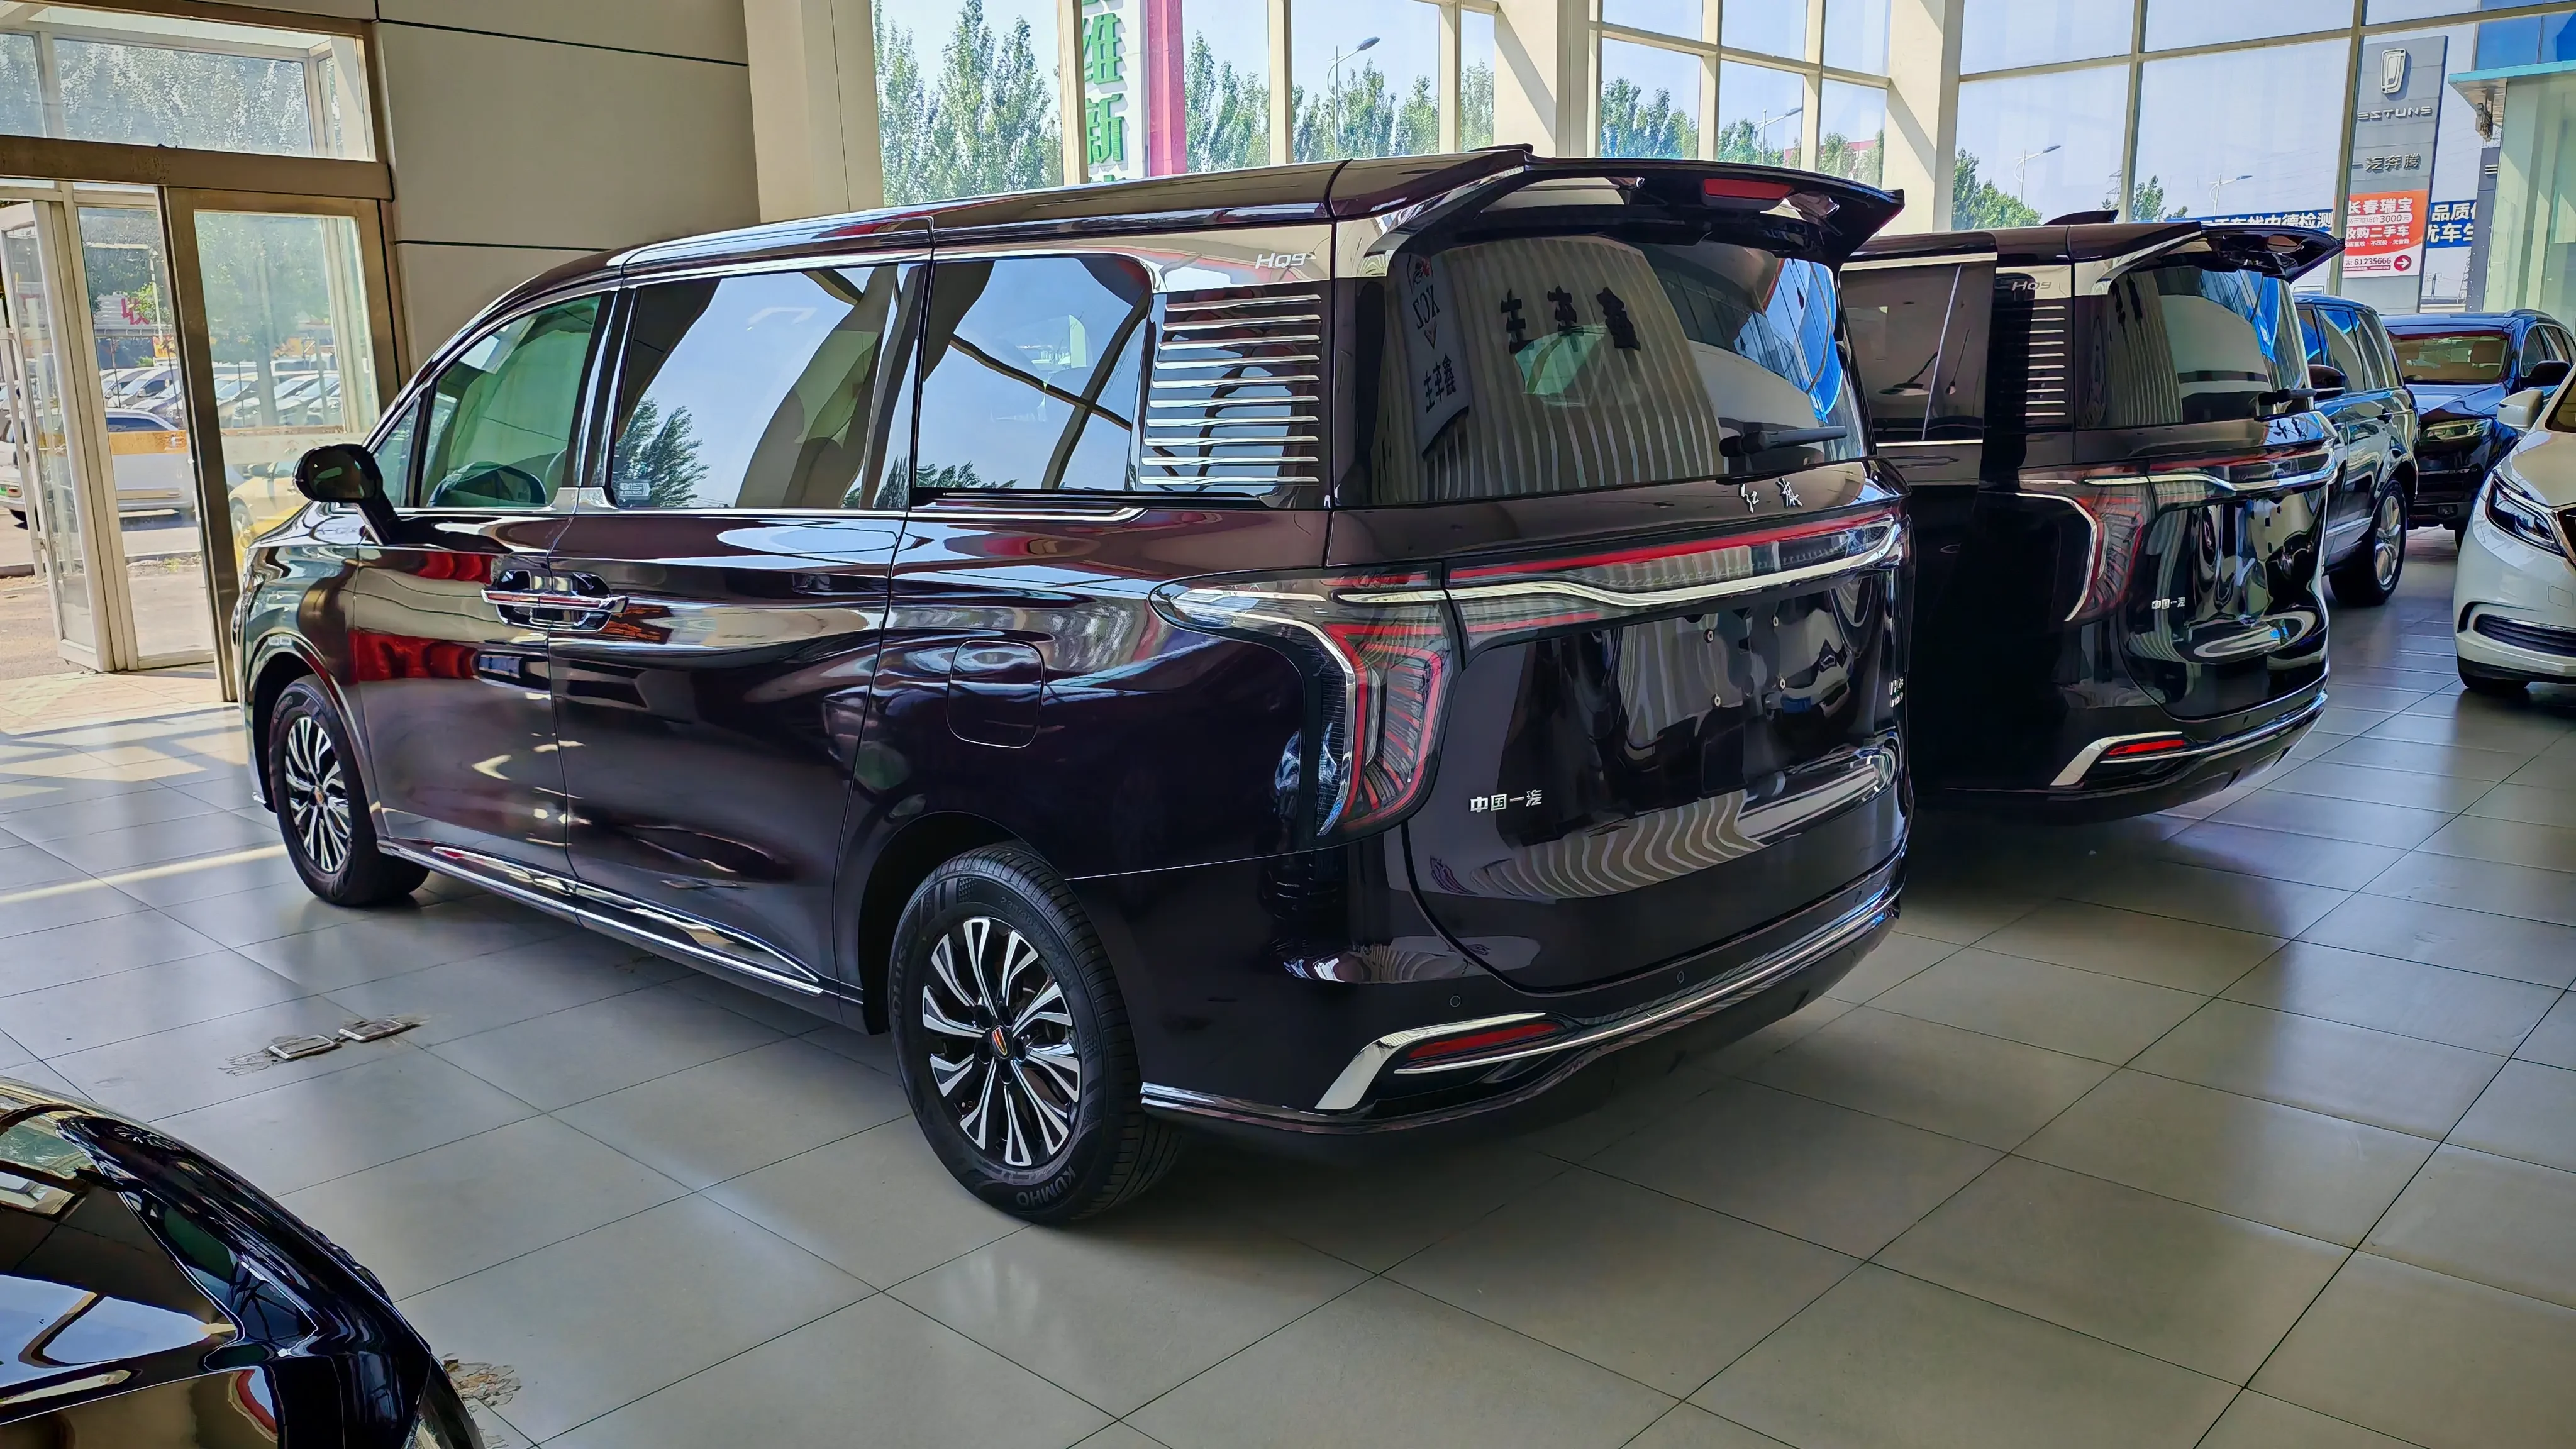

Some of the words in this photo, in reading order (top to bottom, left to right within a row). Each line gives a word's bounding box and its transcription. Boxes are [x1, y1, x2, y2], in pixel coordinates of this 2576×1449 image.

[1082, 0, 1126, 182] 维斯
[2358, 106, 2432, 121] ESTUNE
[2352, 153, 2420, 172] 一汽奔腾
[2348, 197, 2413, 214] 长春瑞宝
[1255, 253, 1306, 269] HQ9
[2354, 257, 2392, 265] 81235666
[2151, 597, 2185, 610] 中国一汽
[1470, 789, 1542, 813] 中国一汽
[1016, 1165, 1076, 1206] KUMHO
